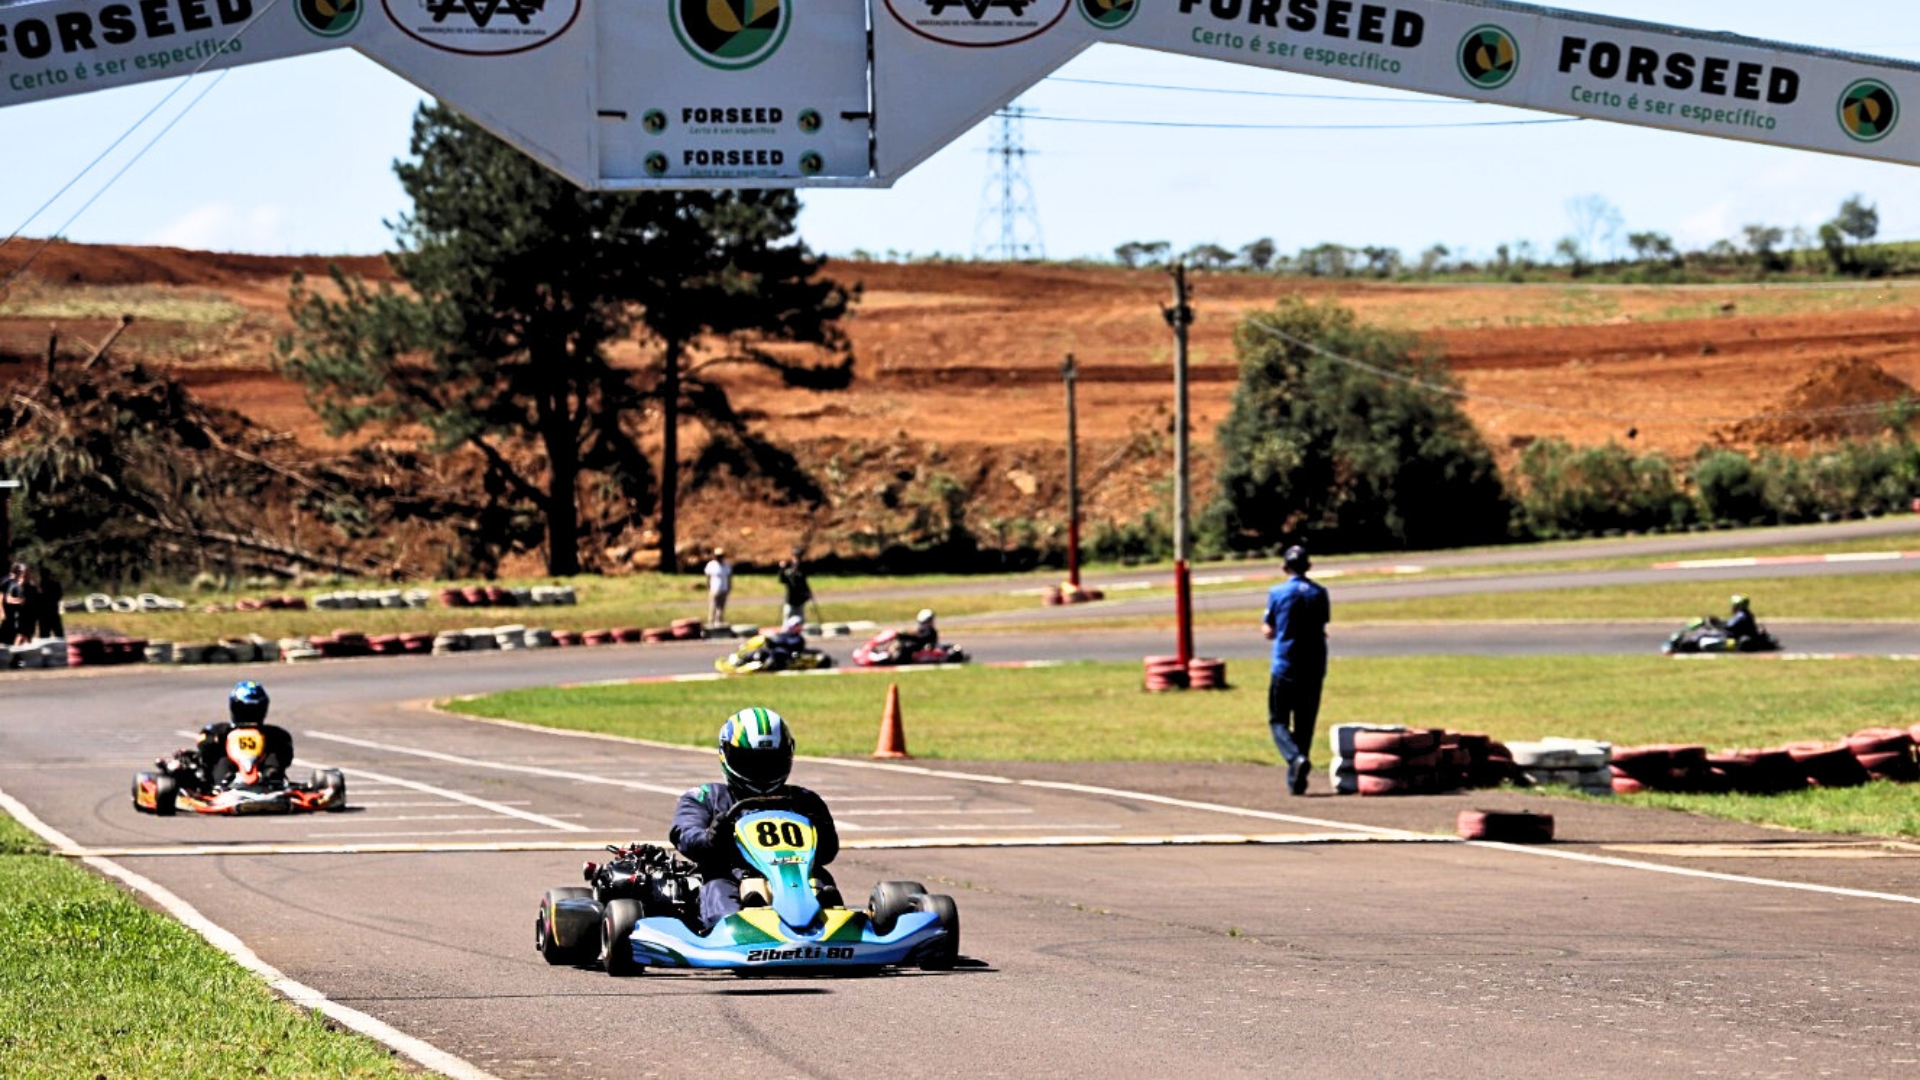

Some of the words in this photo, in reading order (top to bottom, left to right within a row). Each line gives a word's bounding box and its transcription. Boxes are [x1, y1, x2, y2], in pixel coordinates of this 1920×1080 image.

[10, 68, 69, 91] Certo
[74, 61, 88, 80] é
[94, 58, 127, 77] ser
[134, 37, 243, 69] específico
[1192, 26, 1244, 49] Certo
[1250, 34, 1261, 52] é
[1267, 40, 1298, 57] ser
[1304, 45, 1401, 74] específico
[1558, 36, 1800, 105] FORSEED
[682, 107, 783, 124] FORSEED
[1571, 85, 1621, 108] Certo
[1628, 91, 1639, 110] é
[1644, 97, 1674, 115] ser
[1680, 102, 1776, 130] específico
[683, 149, 784, 166] FORSEED
[756, 822, 804, 848] 80
[746, 946, 822, 962] Zibetti
[826, 947, 854, 960] 80
